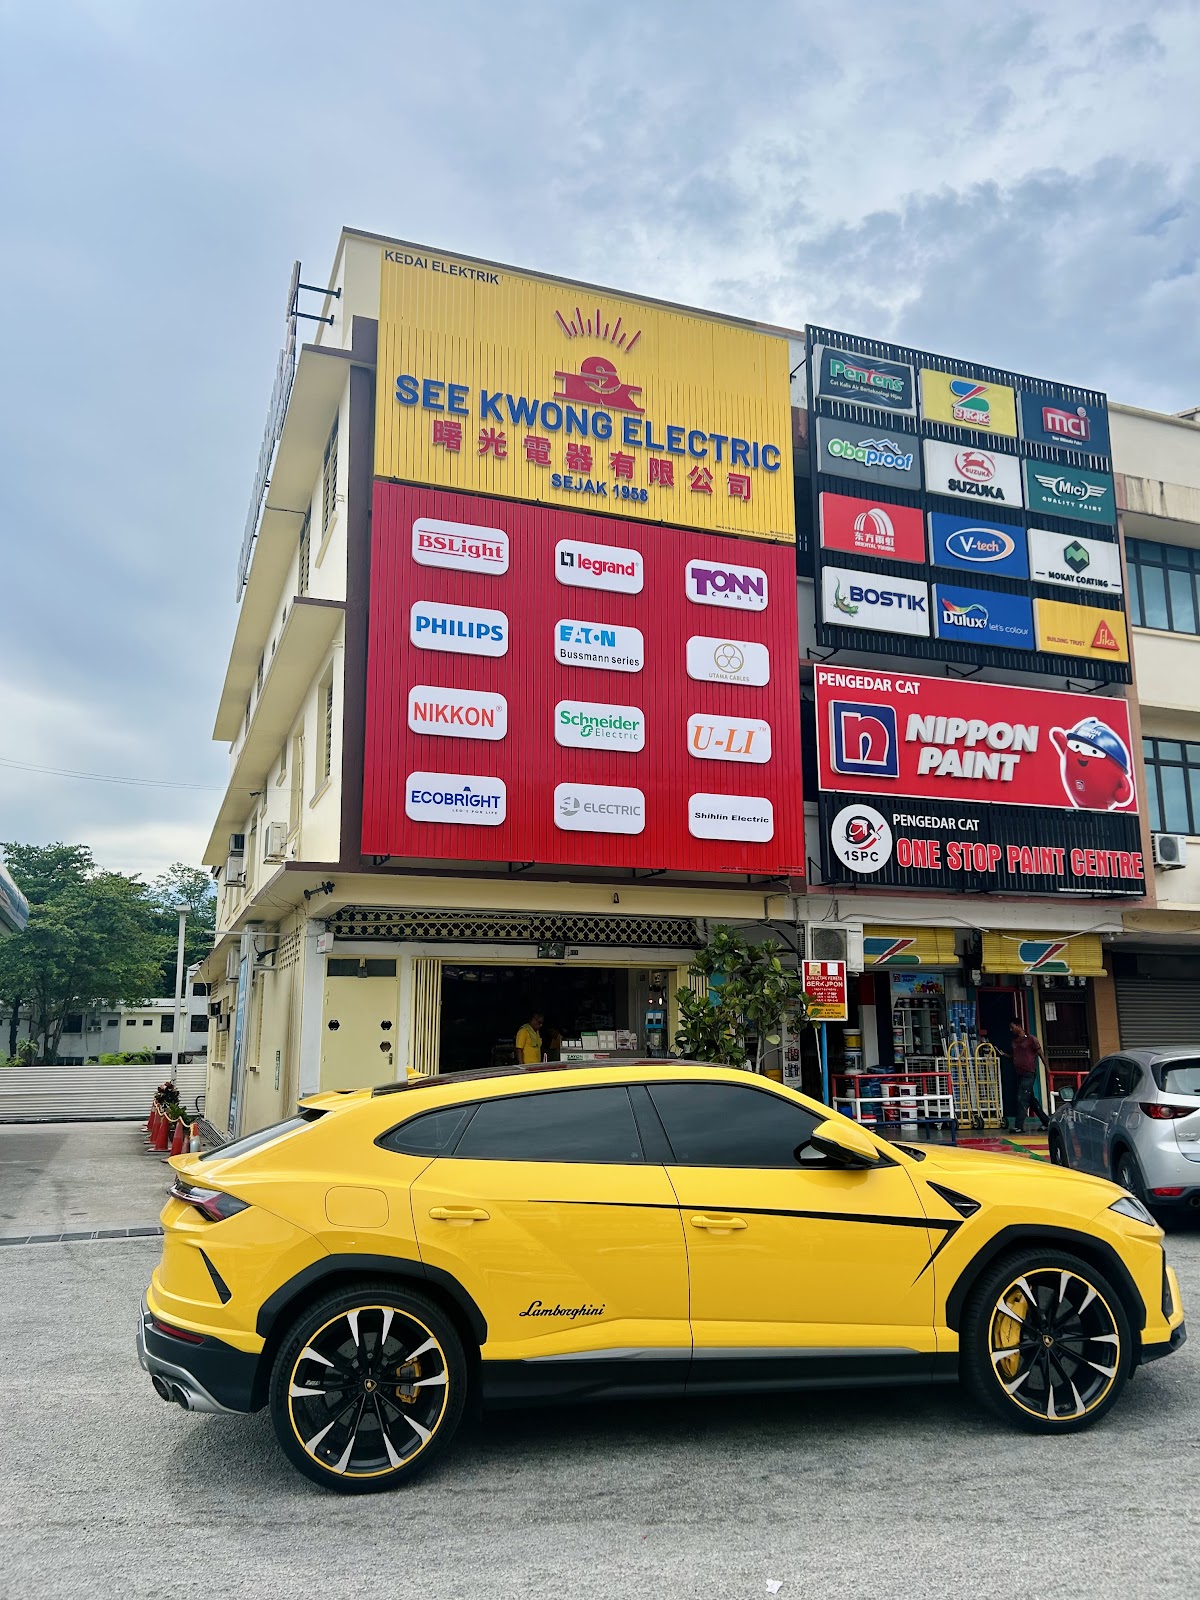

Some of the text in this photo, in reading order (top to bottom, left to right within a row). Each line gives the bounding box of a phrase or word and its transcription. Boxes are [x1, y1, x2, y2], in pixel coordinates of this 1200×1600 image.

[385, 250, 499, 285] KEDAI ELEKTRIK
[830, 359, 904, 392] Pentens
[395, 374, 781, 472] SEE KWONG ELECTRIC
[954, 407, 991, 426] SKK
[1046, 406, 1087, 437] mci
[432, 419, 752, 502] 曙光電器有限公司
[828, 438, 913, 470] Obaproof
[965, 467, 990, 477] SUZUKA
[551, 473, 649, 503] SEJAK 1958
[948, 478, 1005, 501] SUZUKA
[1042, 496, 1102, 512] QUALITY PAINT
[417, 534, 504, 559] BSLight
[959, 536, 1000, 553] V-tech
[577, 553, 635, 576] legrand
[691, 568, 763, 596] TONN
[1048, 571, 1109, 587] MOKAY COATING
[711, 591, 764, 603] CABLE
[849, 585, 926, 612] BOSTIK
[415, 615, 504, 641] PHILIPS
[943, 610, 984, 629] Dulux
[1005, 625, 1029, 635] colour
[1046, 635, 1085, 647] BUILDING TRUST
[1096, 628, 1116, 647] Sika
[560, 648, 640, 666] Bussmann series
[708, 672, 729, 680] UTAMA
[818, 672, 920, 695] PENGEDAR CAT
[414, 702, 495, 728] NIKKON
[560, 710, 640, 731] Schneider
[595, 728, 639, 740] Electric
[693, 725, 756, 754] U-LI
[905, 713, 1039, 752] NIPPON
[917, 746, 1020, 782] PAINT
[411, 790, 501, 809] ECOBRIGHT
[584, 802, 641, 816] ELECTRIC
[694, 812, 769, 823] Shihlin Electric
[892, 813, 980, 831] PENGEDAR CAT
[844, 850, 879, 862] 1SPC
[896, 838, 1145, 879] ONE STOP PAINT CENTRE
[519, 1300, 606, 1319] Lamborghini
